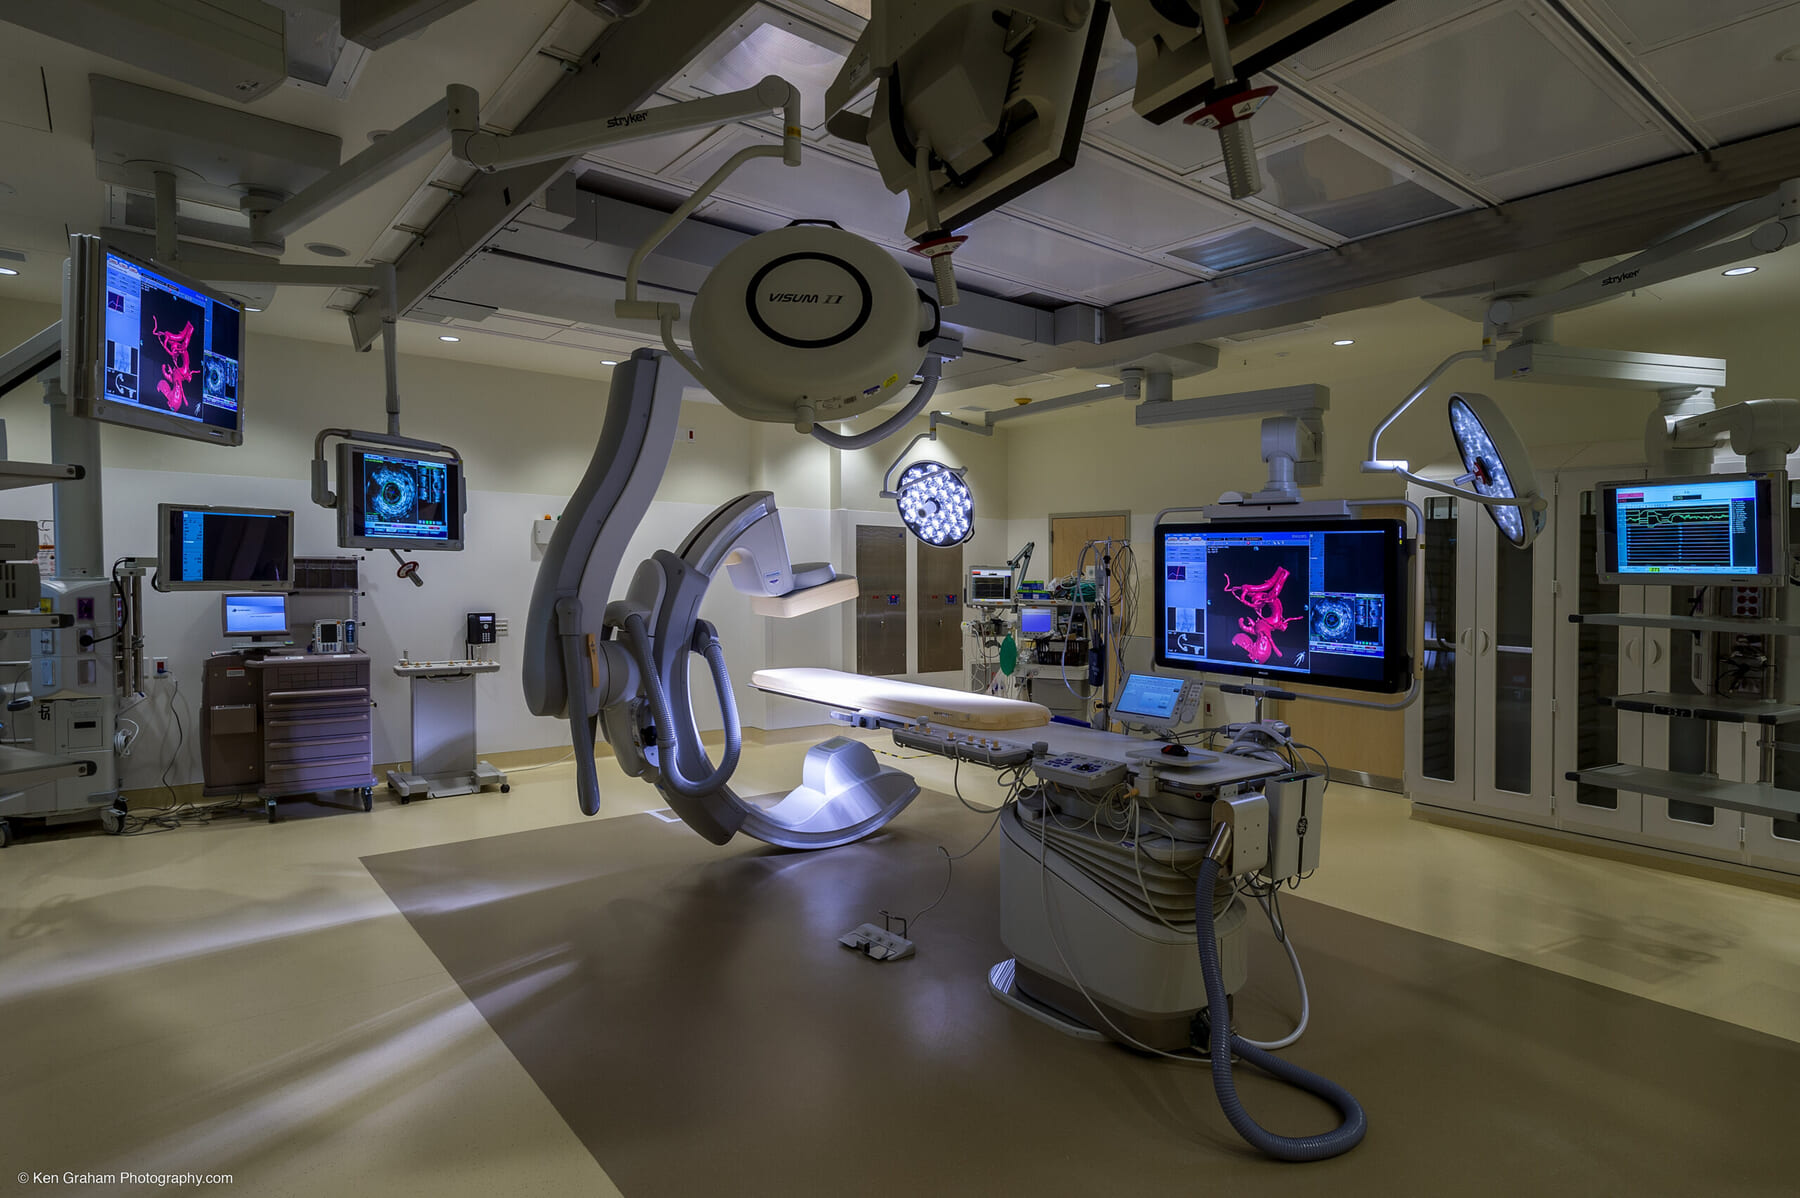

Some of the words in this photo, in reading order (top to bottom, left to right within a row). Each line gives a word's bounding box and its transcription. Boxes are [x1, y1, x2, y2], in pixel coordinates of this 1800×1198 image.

[607, 111, 648, 128] stryker
[1601, 269, 1641, 286] stryker
[769, 293, 819, 304] VISUM
[823, 294, 843, 304] II
